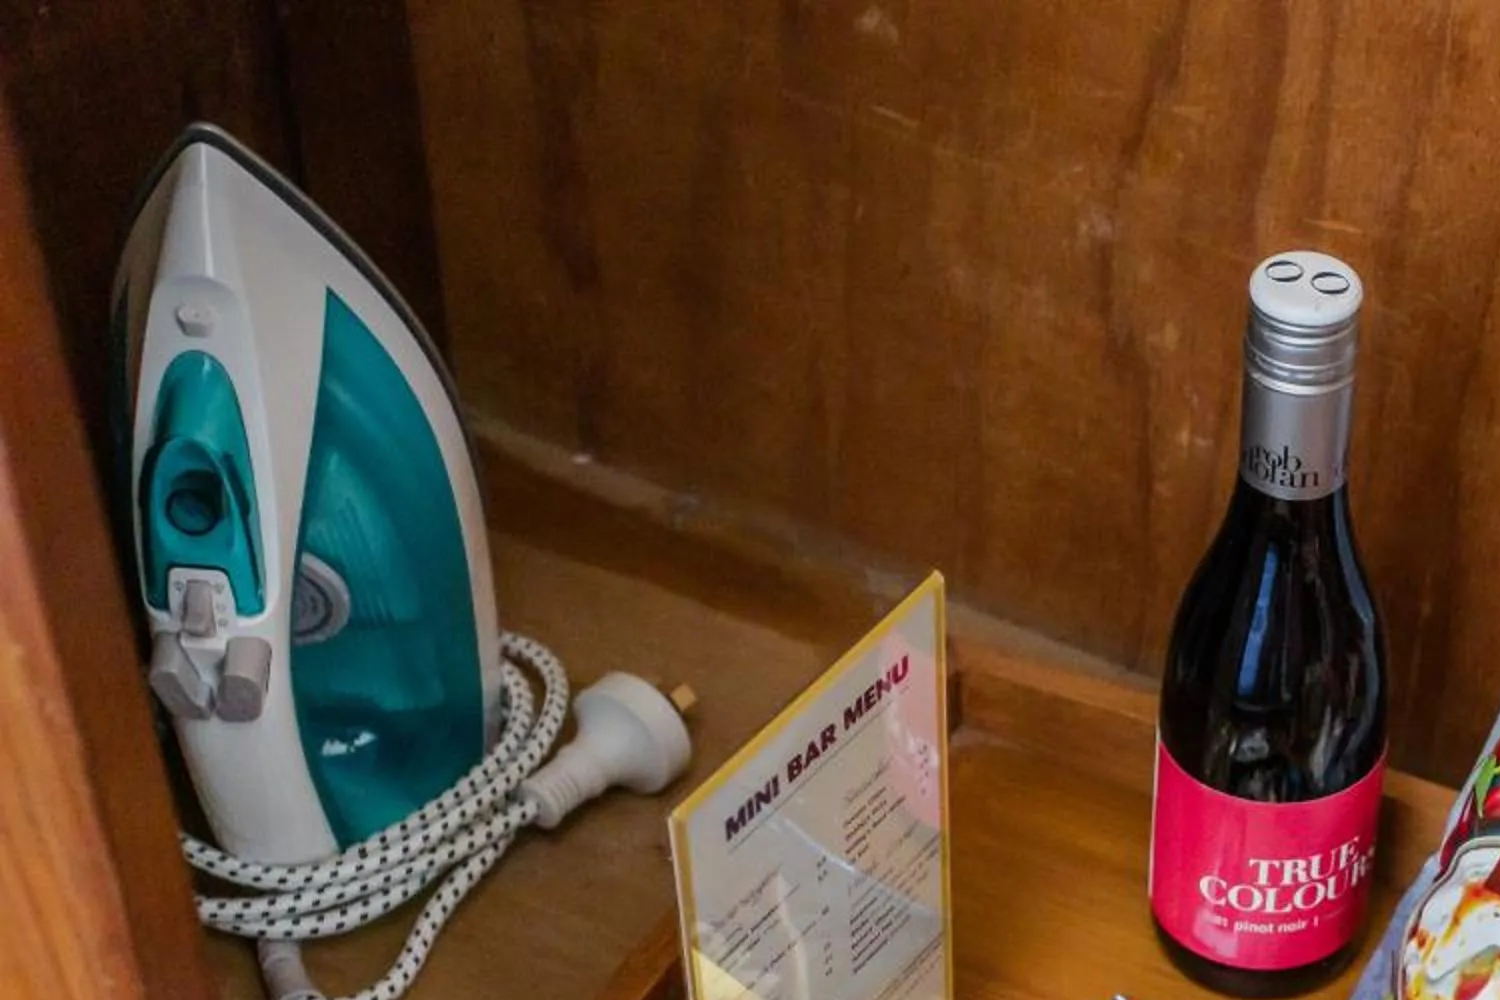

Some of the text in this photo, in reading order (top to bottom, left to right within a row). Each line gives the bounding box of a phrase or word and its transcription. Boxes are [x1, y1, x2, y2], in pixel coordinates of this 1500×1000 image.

[725, 774, 780, 841] MINI
[786, 723, 837, 783] BAR
[843, 654, 909, 731] MENU
[1249, 836, 1360, 886] TRUE
[1234, 918, 1274, 934] pinot
[1277, 918, 1308, 933] noir
